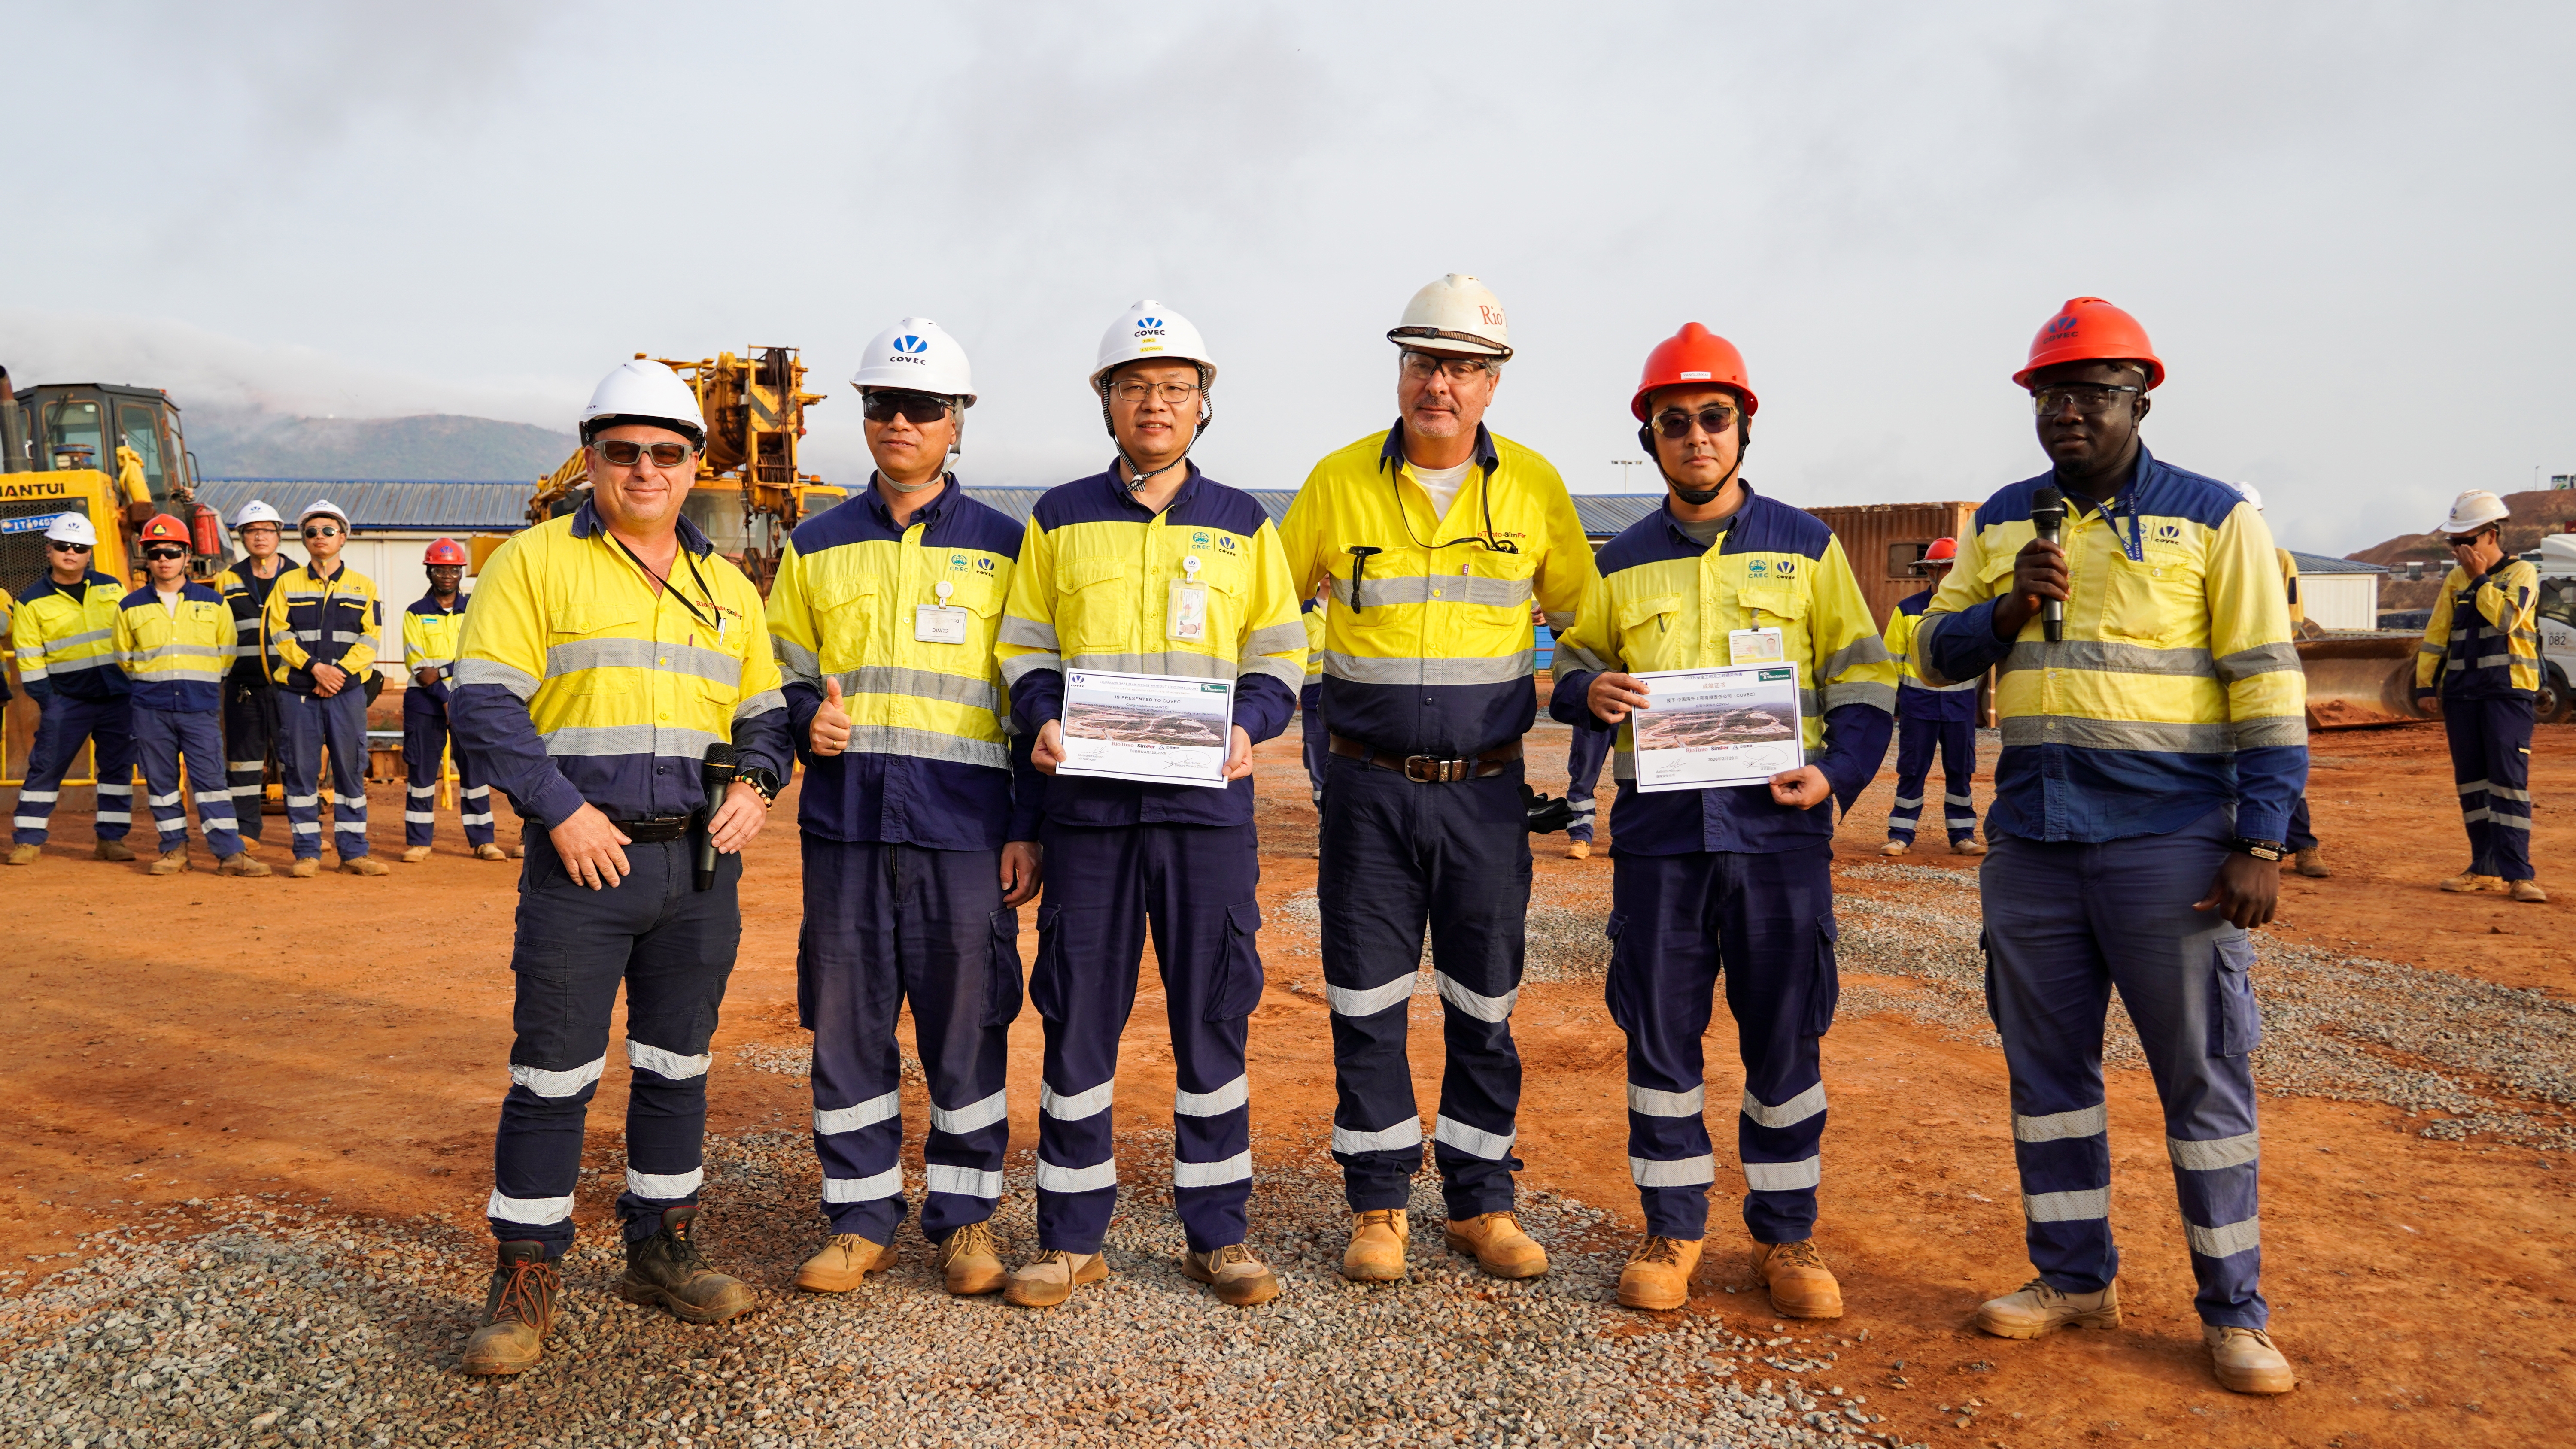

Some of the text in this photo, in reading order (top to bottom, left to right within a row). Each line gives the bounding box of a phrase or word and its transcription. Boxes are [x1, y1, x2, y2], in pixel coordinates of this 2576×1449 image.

[1478, 305, 1502, 325] Rio
[2043, 331, 2078, 344] COVEC
[890, 356, 926, 365] COVEC
[2549, 636, 2566, 646] 082
